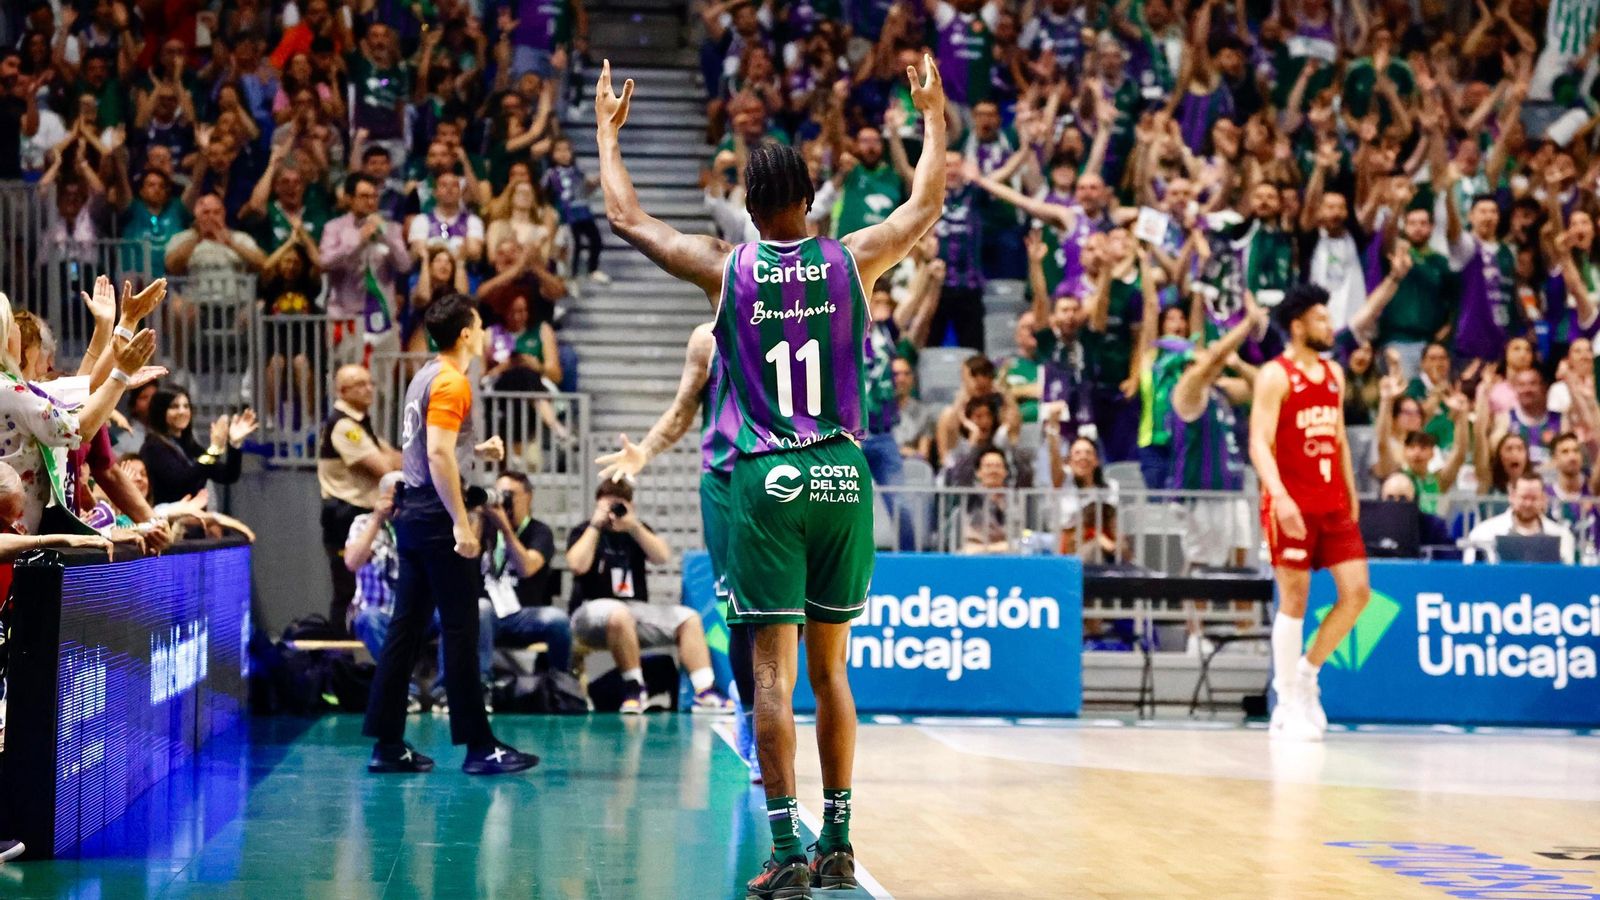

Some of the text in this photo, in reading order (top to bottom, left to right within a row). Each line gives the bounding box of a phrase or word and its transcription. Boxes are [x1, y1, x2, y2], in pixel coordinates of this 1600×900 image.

[752, 260, 831, 283] Carter
[765, 338, 821, 417] 11
[809, 465, 859, 478] COSTA
[1319, 457, 1332, 483] 4
[809, 491, 860, 503] MÁLAGA
[810, 480, 860, 491] DEL SOL
[846, 627, 991, 681] nicaja
[1417, 633, 1597, 690] Unicaja
